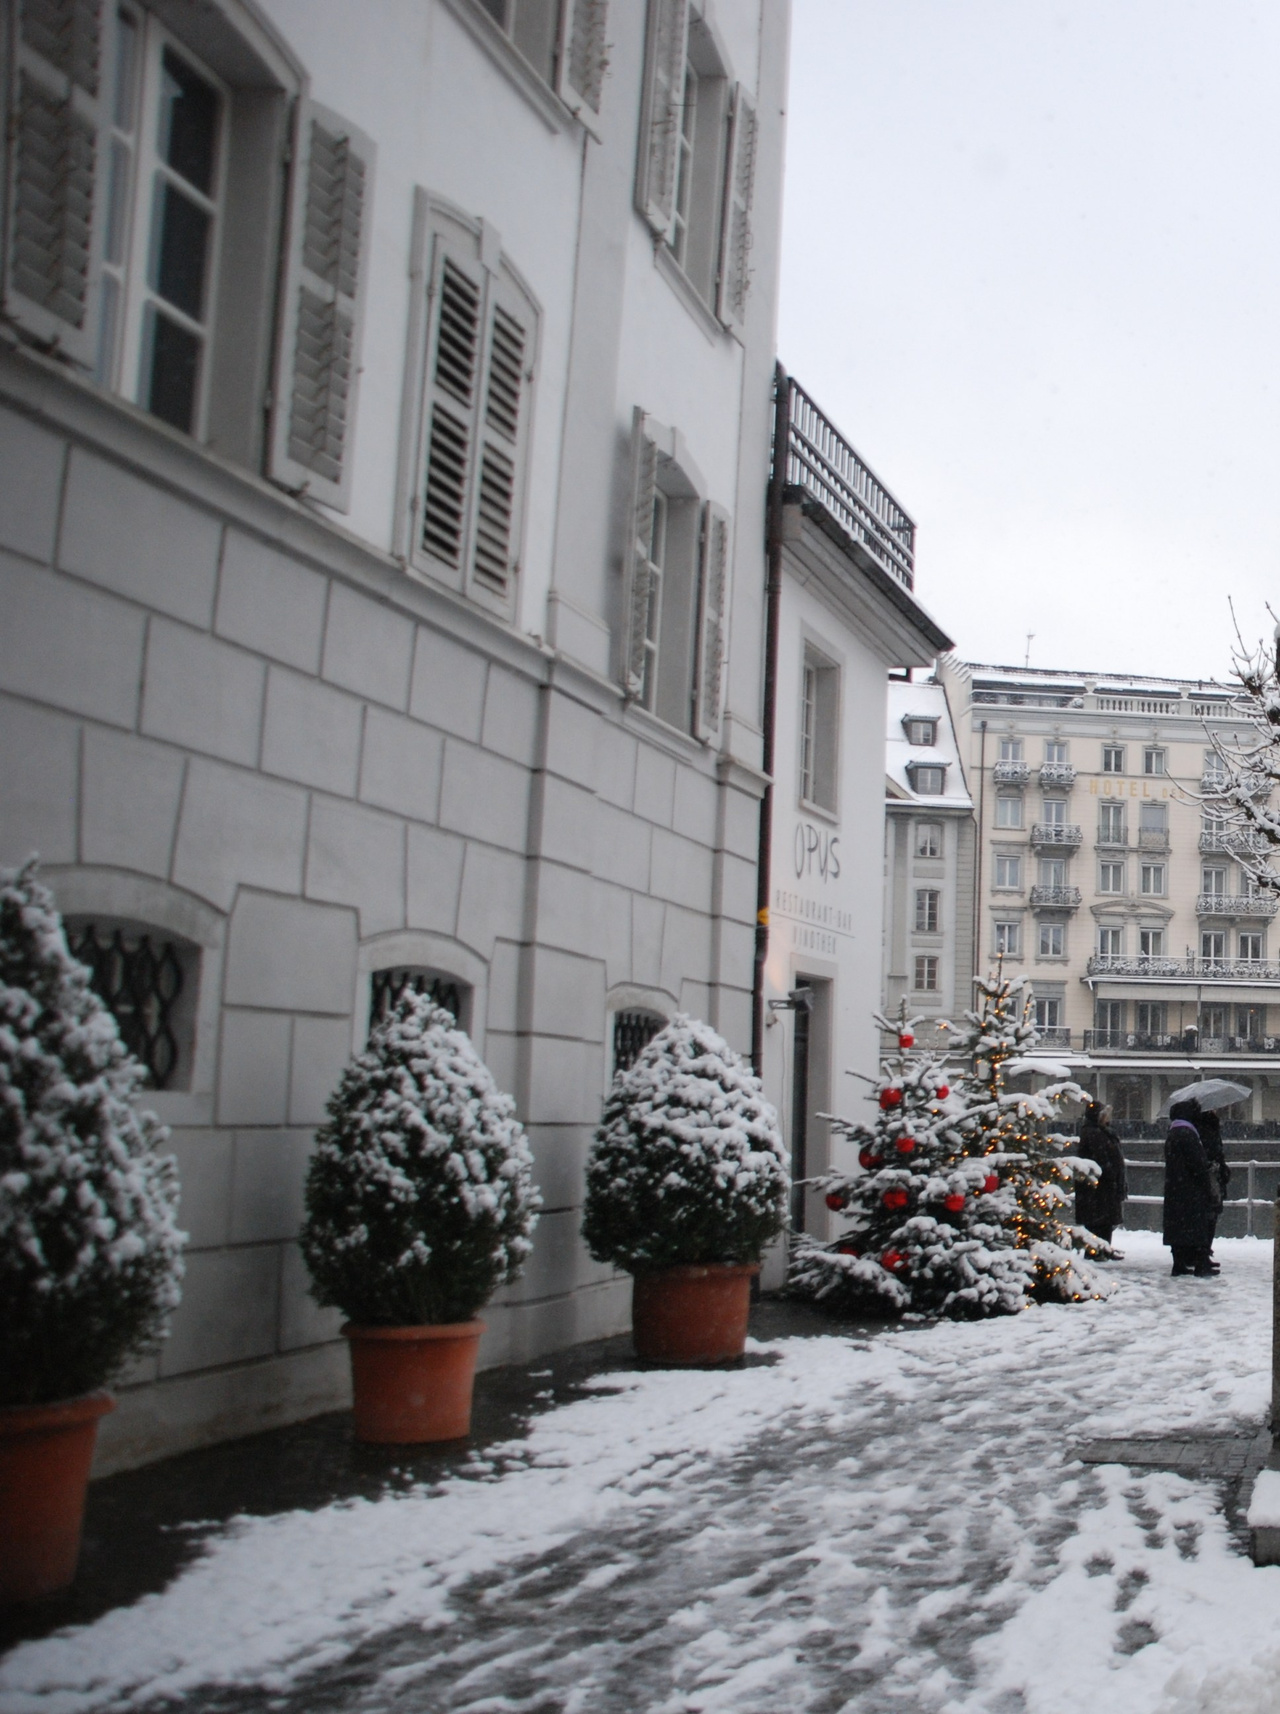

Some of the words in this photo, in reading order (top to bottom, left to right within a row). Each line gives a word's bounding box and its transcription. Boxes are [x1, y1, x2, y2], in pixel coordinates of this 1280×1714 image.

[1089, 779, 1151, 798] HOTEL
[1162, 787, 1185, 799] DES
[794, 822, 841, 884] OPUS
